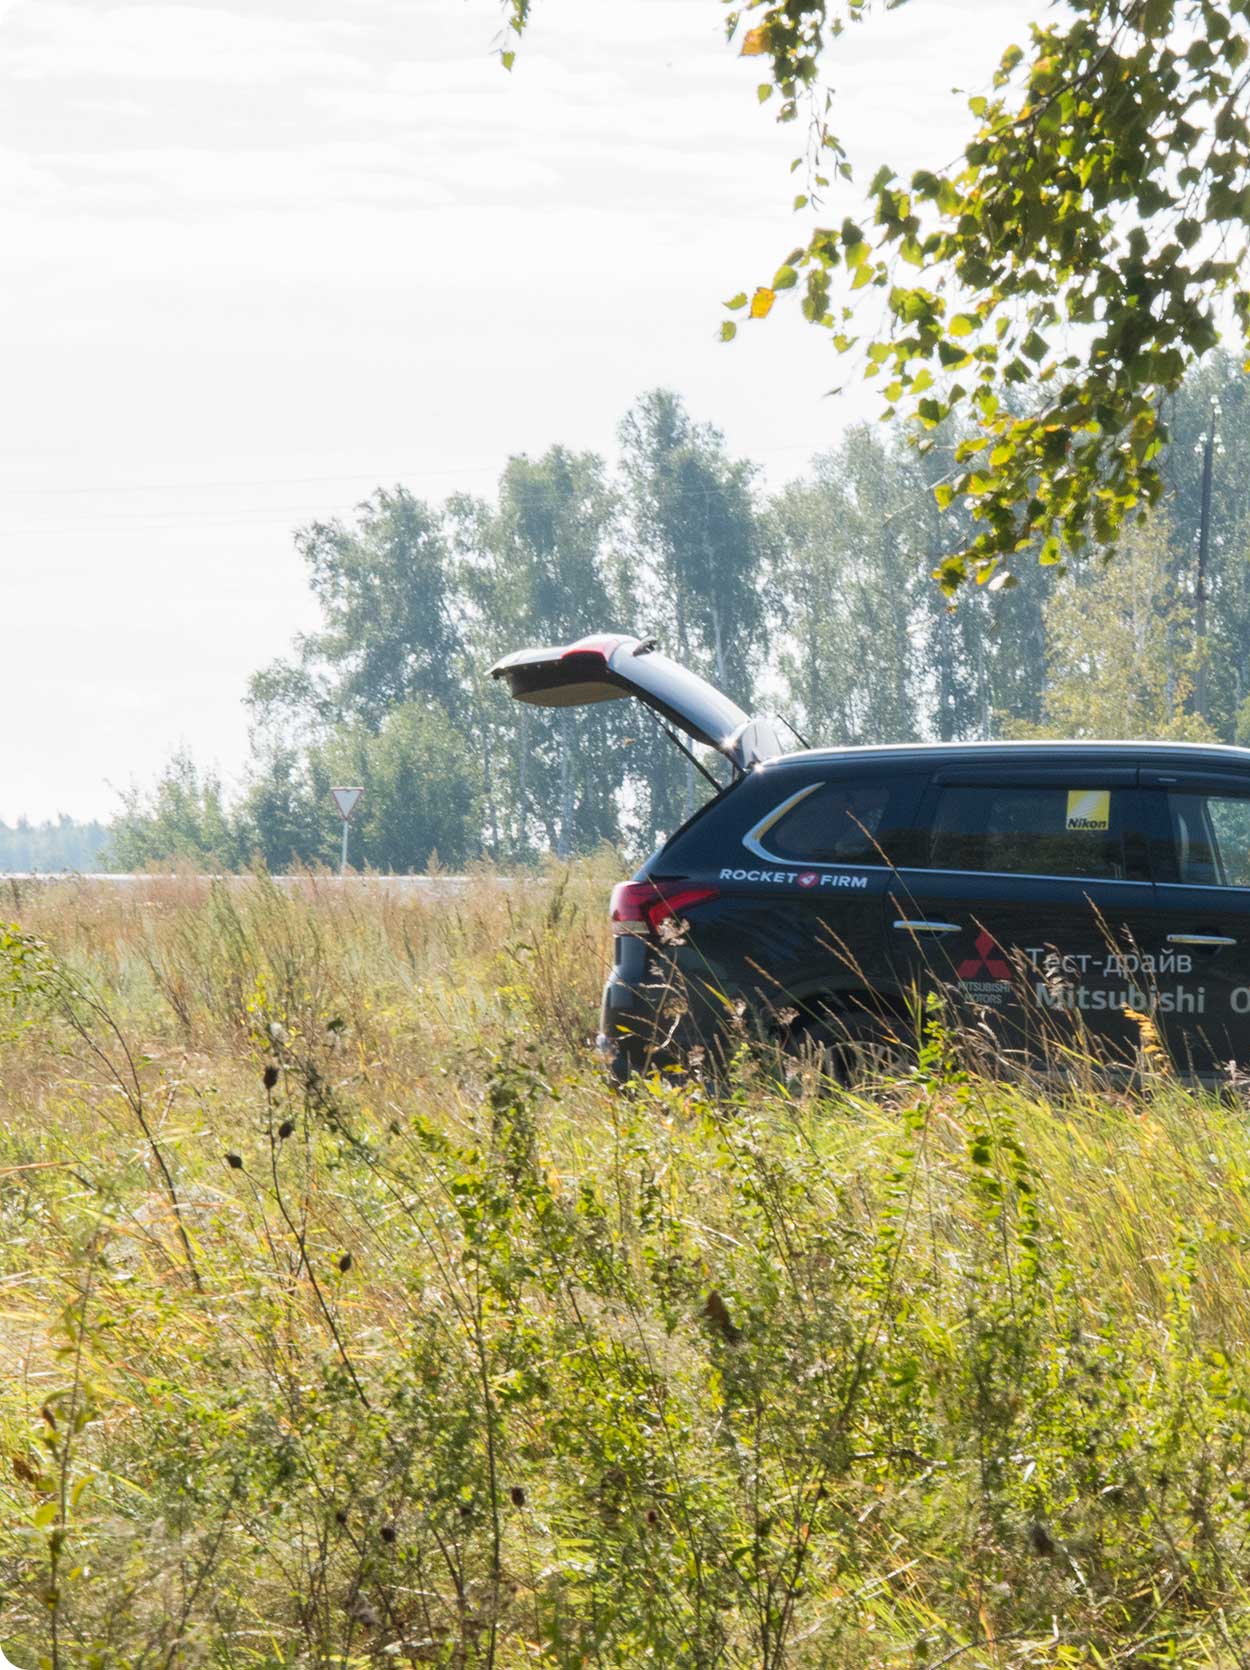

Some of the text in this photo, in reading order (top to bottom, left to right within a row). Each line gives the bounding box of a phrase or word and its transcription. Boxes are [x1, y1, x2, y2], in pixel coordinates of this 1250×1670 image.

[1067, 817, 1107, 830] Nikon
[719, 868, 869, 889] ROCKET FIRM
